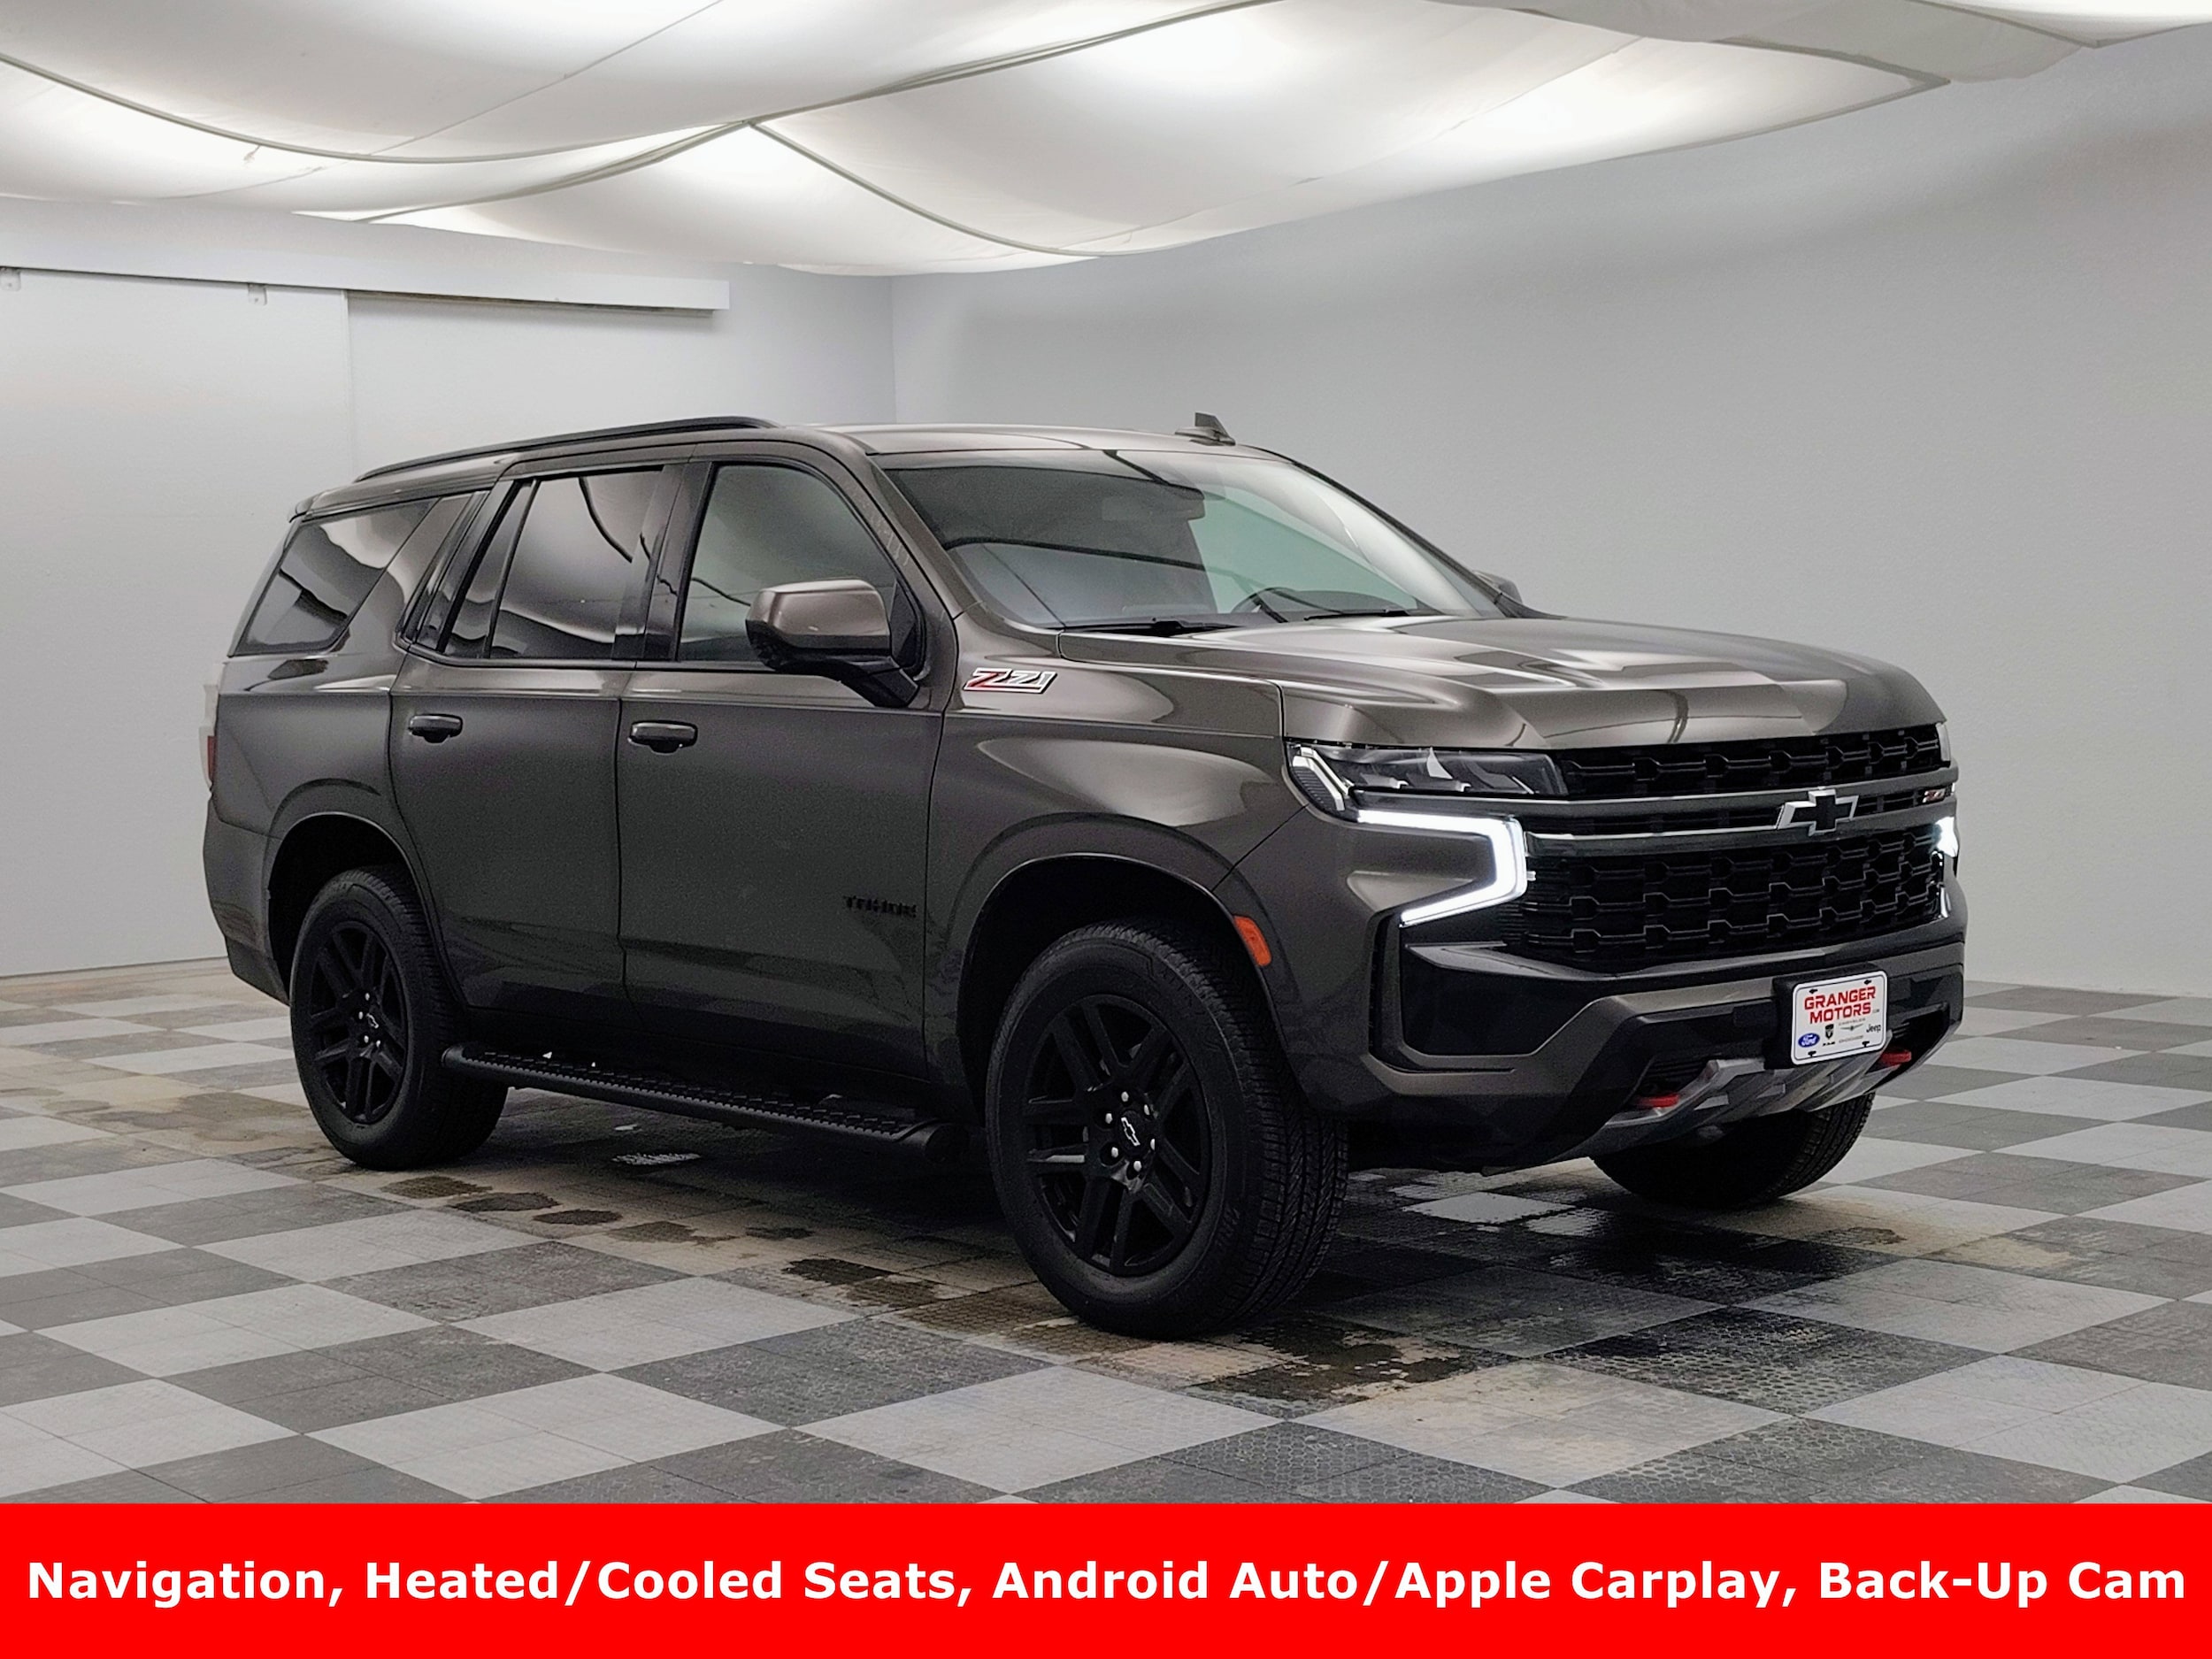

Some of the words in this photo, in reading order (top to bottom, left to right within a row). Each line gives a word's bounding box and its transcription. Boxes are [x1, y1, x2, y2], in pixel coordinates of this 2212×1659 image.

[963, 667, 1058, 695] Z71
[1804, 986, 1877, 1010] GRANGER
[1809, 1002, 1871, 1024] MOTORS
[1866, 1024, 1881, 1033] Jeep
